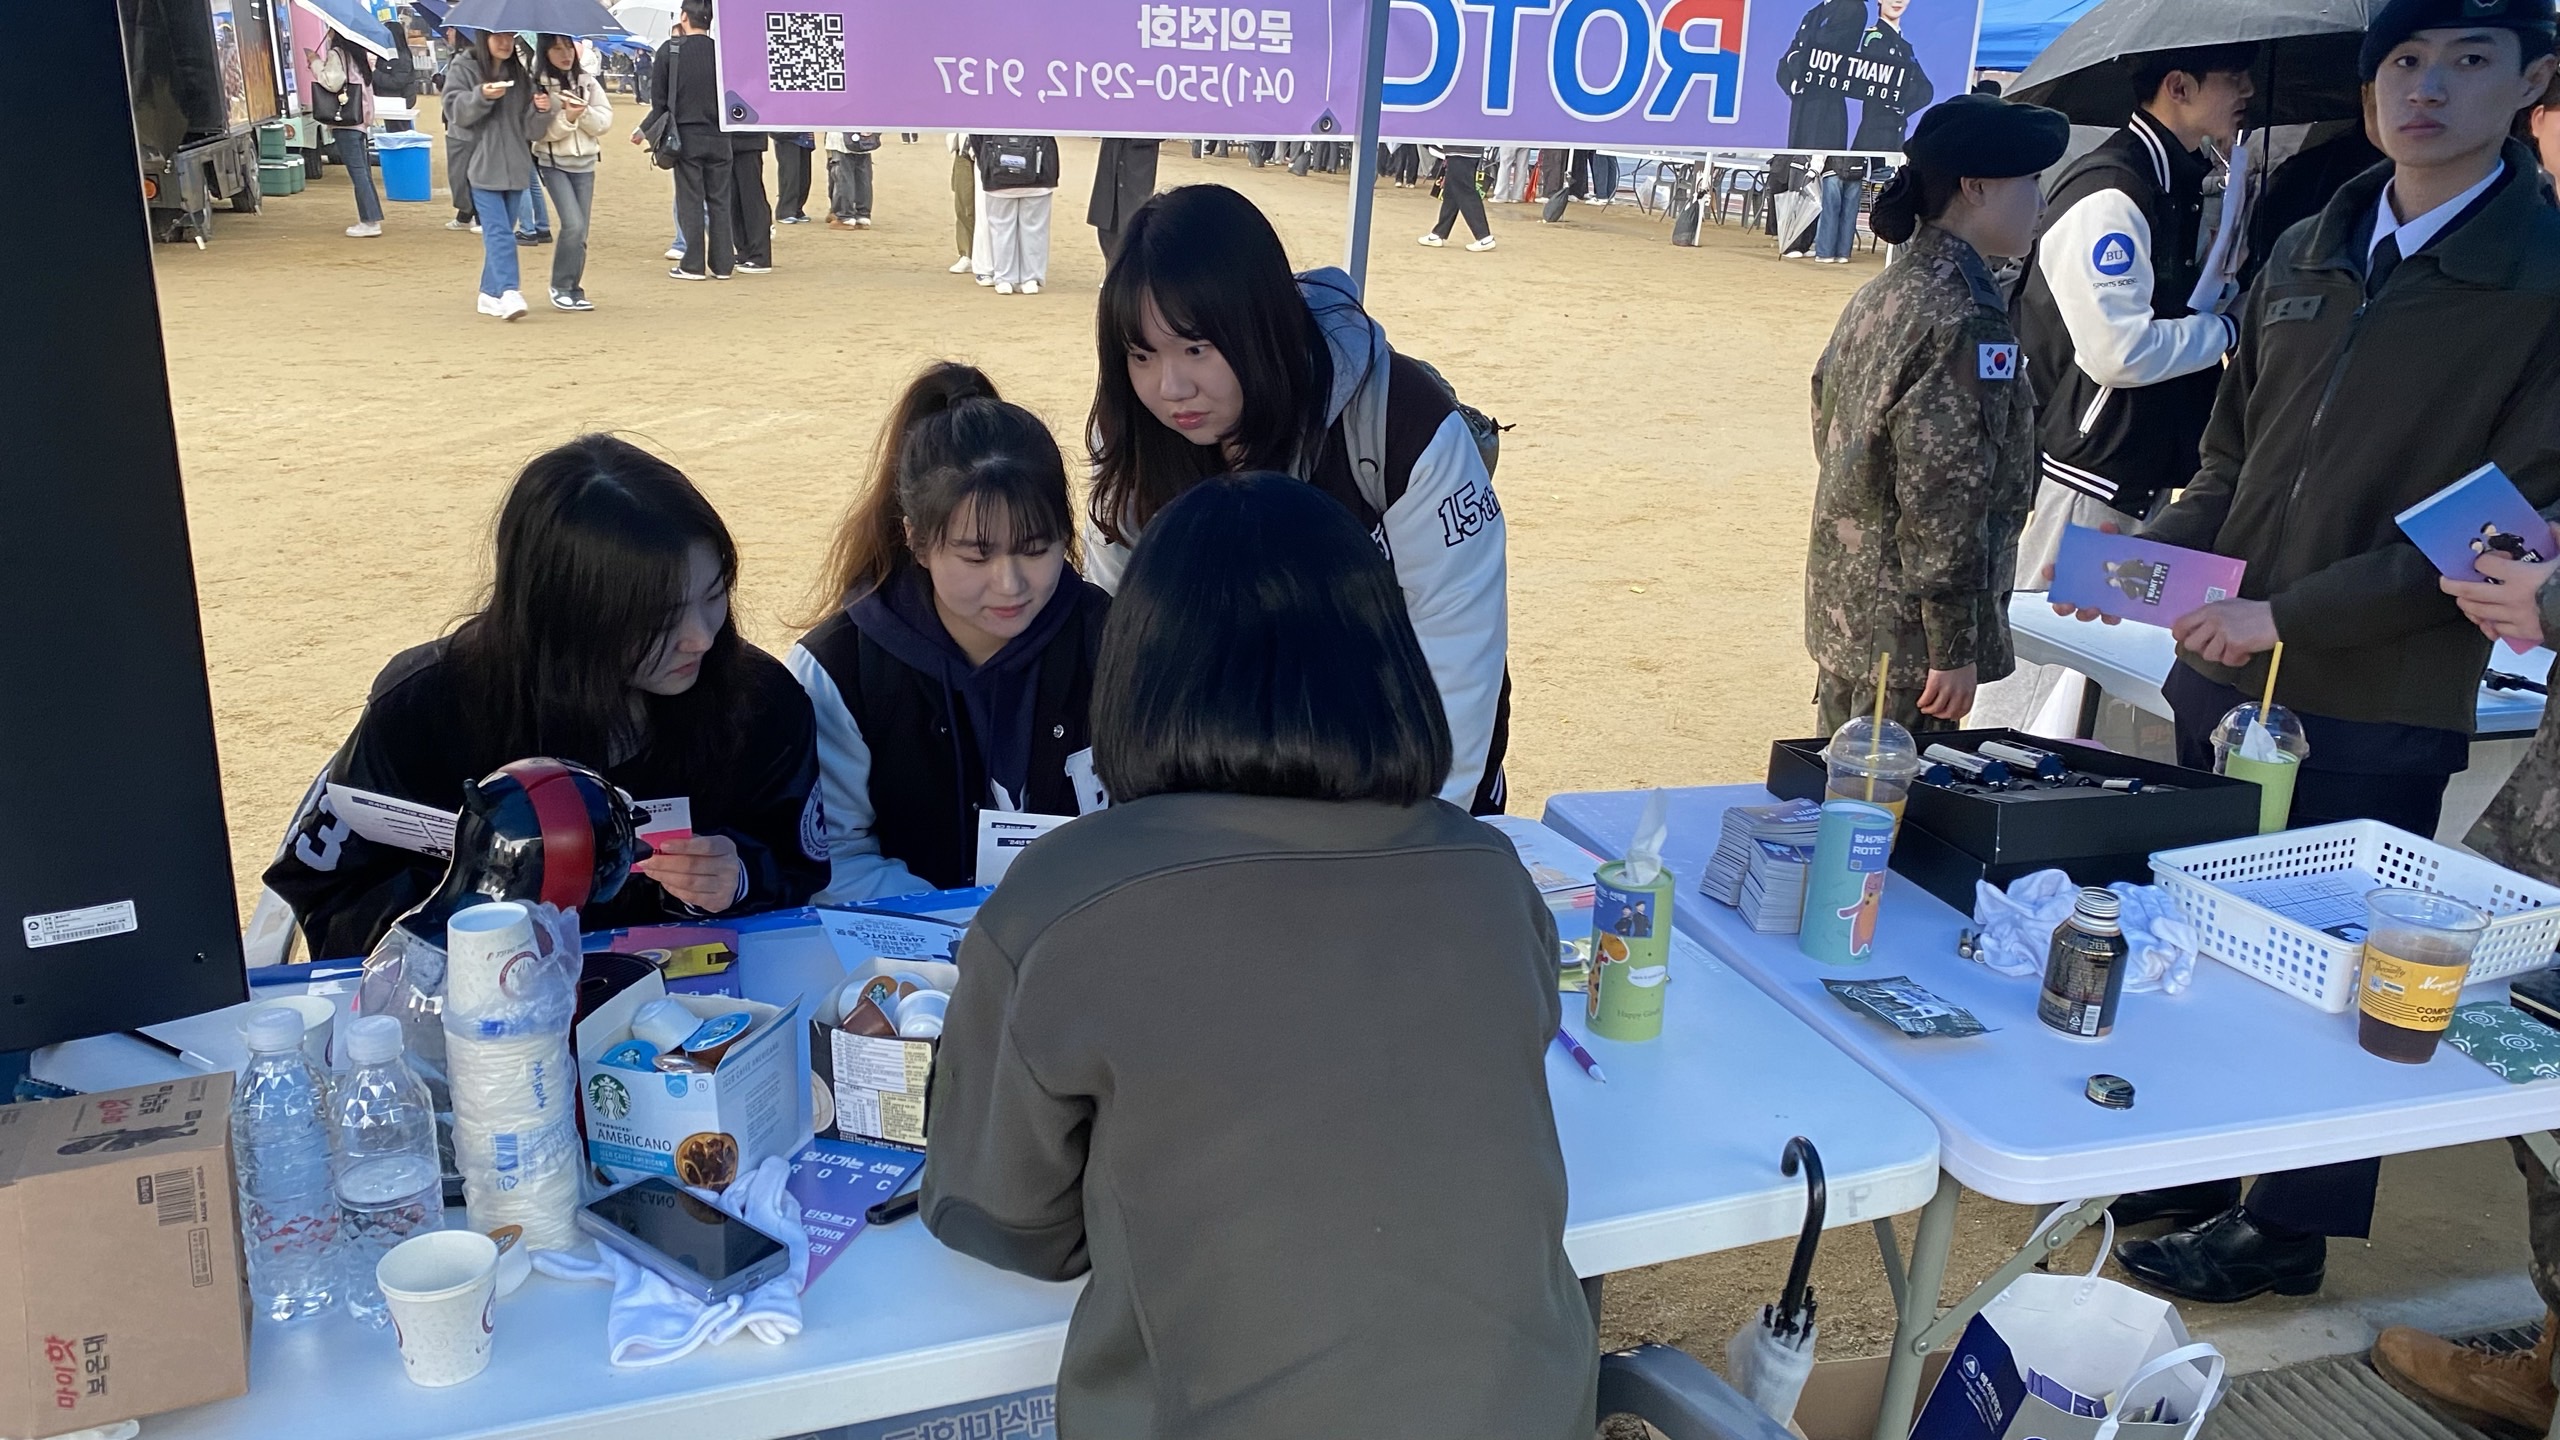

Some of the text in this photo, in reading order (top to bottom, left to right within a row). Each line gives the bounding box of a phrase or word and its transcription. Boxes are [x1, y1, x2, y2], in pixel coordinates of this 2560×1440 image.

[2106, 249, 2124, 261] BU
[2092, 281, 2117, 289] SPORTS
[1438, 481, 1501, 547] 15th
[2521, 551, 2537, 562] OU
[2146, 579, 2158, 598] WANT
[2152, 564, 2163, 578] YOU
[1852, 846, 1882, 855] ROTC
[2416, 1005, 2454, 1015] COMPO
[2420, 1014, 2451, 1023] COFF
[597, 1128, 672, 1151] AMERICANO
[801, 1150, 905, 1178] 앞서가는 선택
[43, 1334, 80, 1409] 마이핫
[82, 1332, 110, 1397] 보온대
